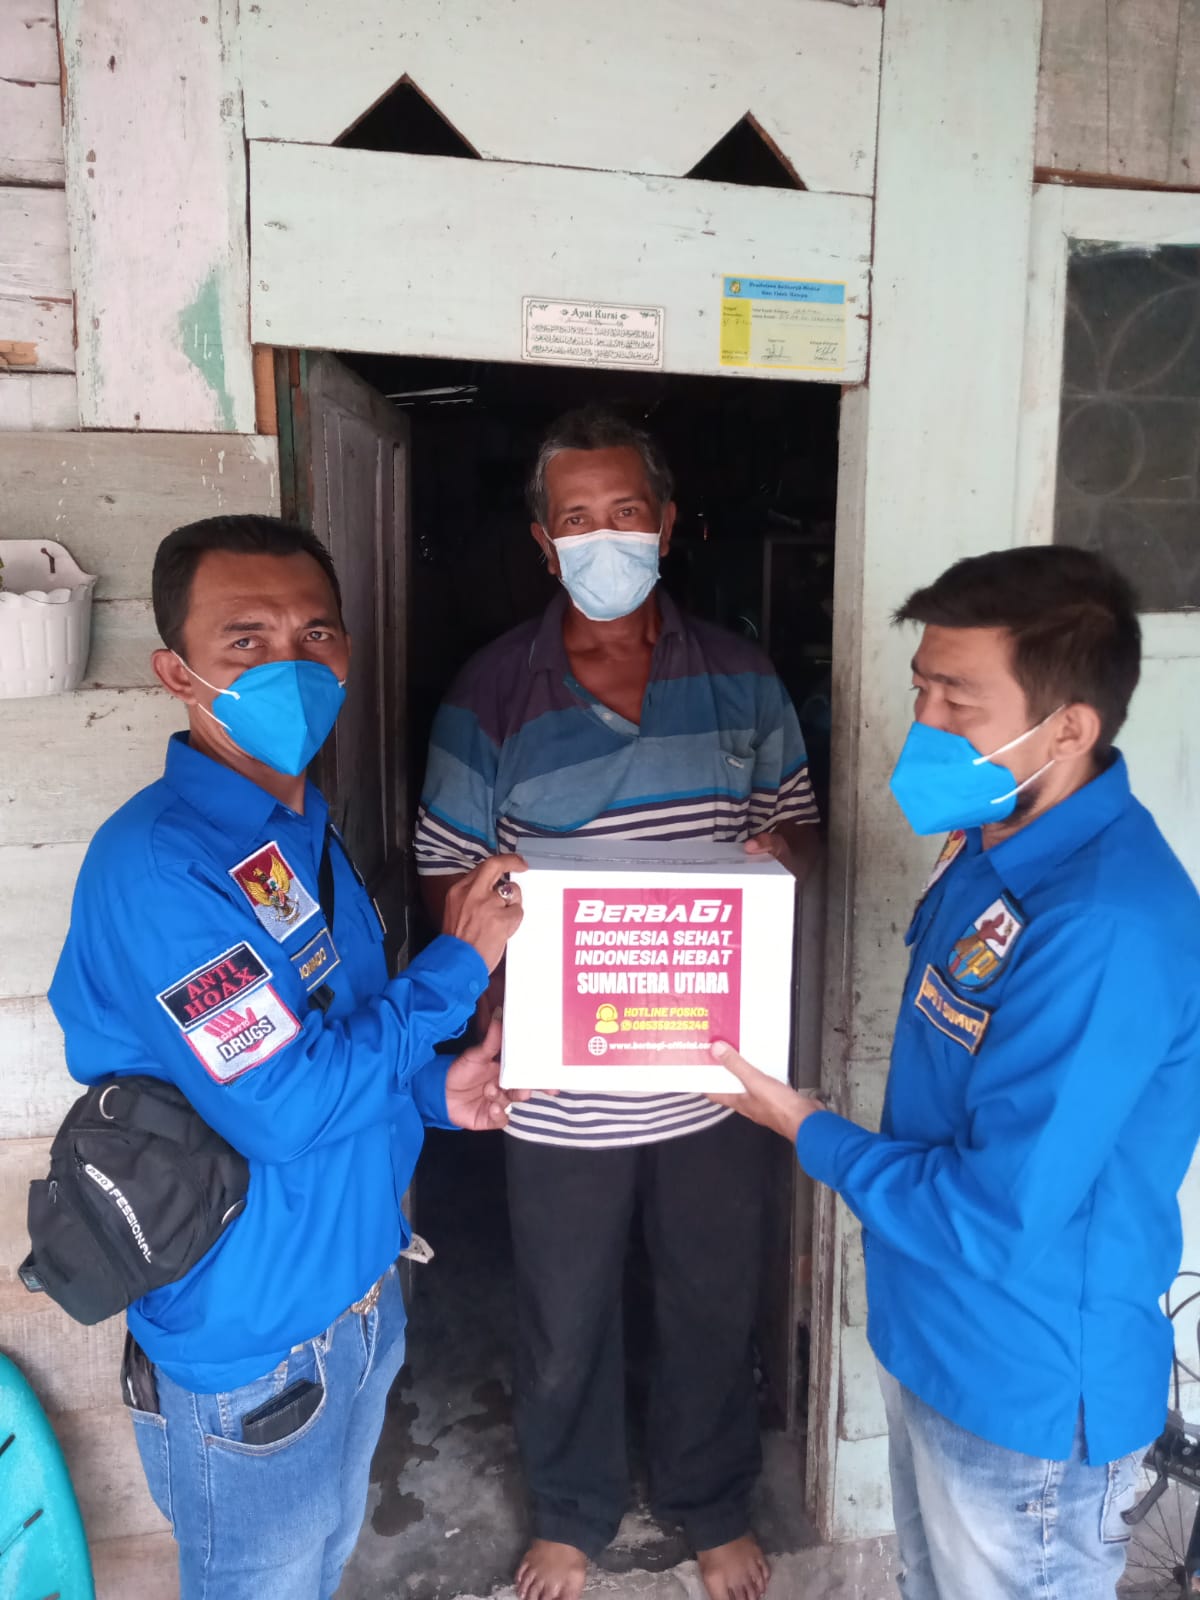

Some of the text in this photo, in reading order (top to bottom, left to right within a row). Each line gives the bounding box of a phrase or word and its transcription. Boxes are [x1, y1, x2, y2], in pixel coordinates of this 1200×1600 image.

[575, 930, 733, 946] INDONESIA SEHAT
[575, 949, 733, 966] INDONESIA HEBAT
[185, 959, 239, 1000] ANTI
[577, 972, 729, 994] SUMATERA UTARA
[184, 966, 257, 1019] HOAX
[624, 1007, 708, 1017] HOTLINE POSKO:
[219, 1019, 272, 1060] DRUGS
